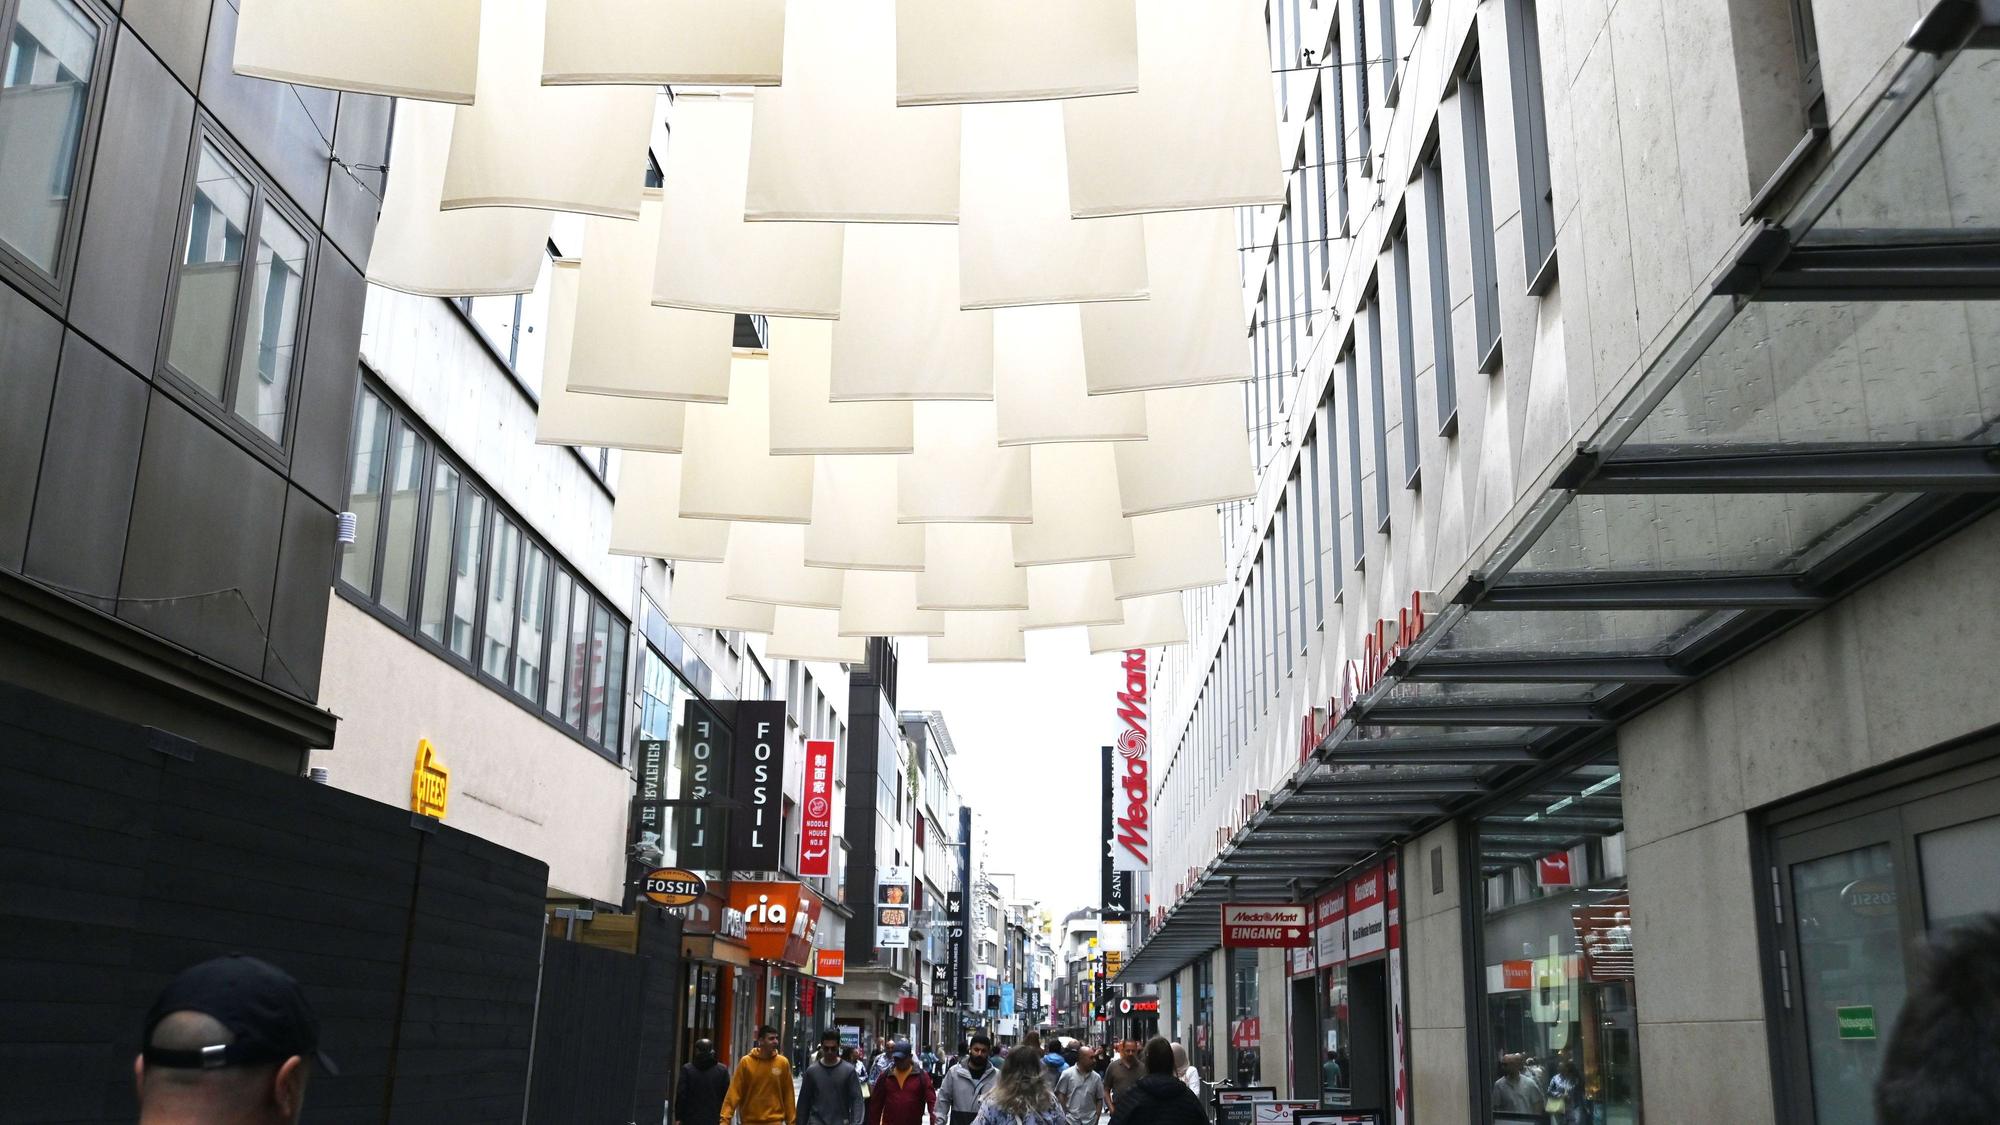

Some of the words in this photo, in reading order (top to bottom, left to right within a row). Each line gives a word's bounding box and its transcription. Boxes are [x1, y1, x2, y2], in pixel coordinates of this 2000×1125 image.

[751, 721, 770, 849] FOSSIL
[808, 829, 828, 837] HOUSE
[646, 879, 698, 895] FOSSIL
[744, 894, 787, 923] ria
[1231, 927, 1282, 940] EINGANG
